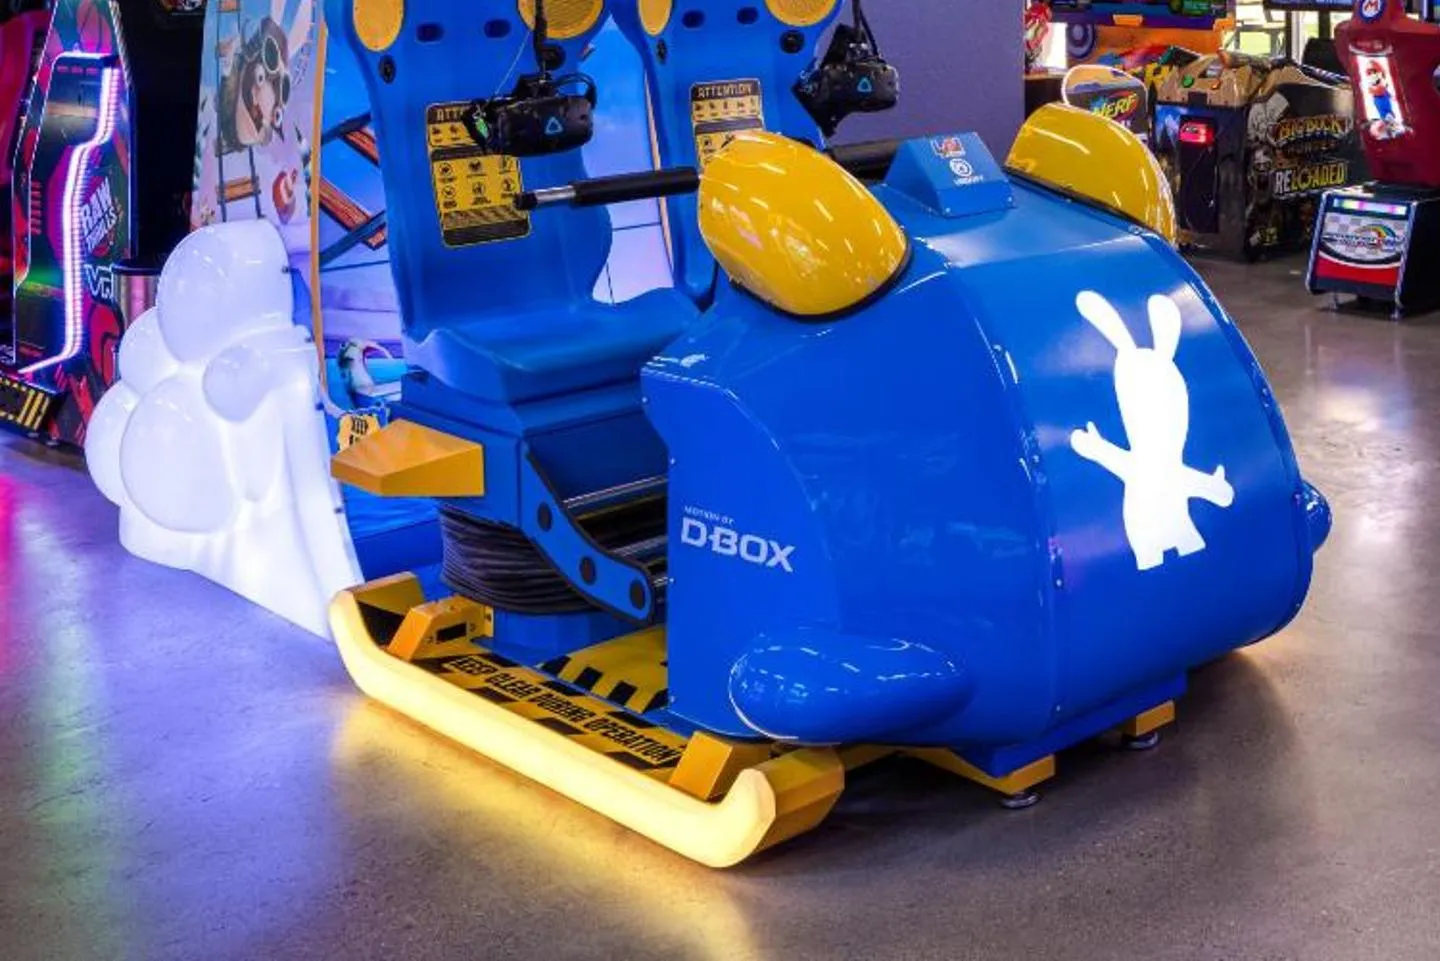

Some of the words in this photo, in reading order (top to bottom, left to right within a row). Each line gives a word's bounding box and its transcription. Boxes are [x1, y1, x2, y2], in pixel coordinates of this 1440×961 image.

[681, 516, 796, 573] D-BOX
[487, 673, 541, 699] CLEAR
[585, 714, 681, 762] OPERATION
